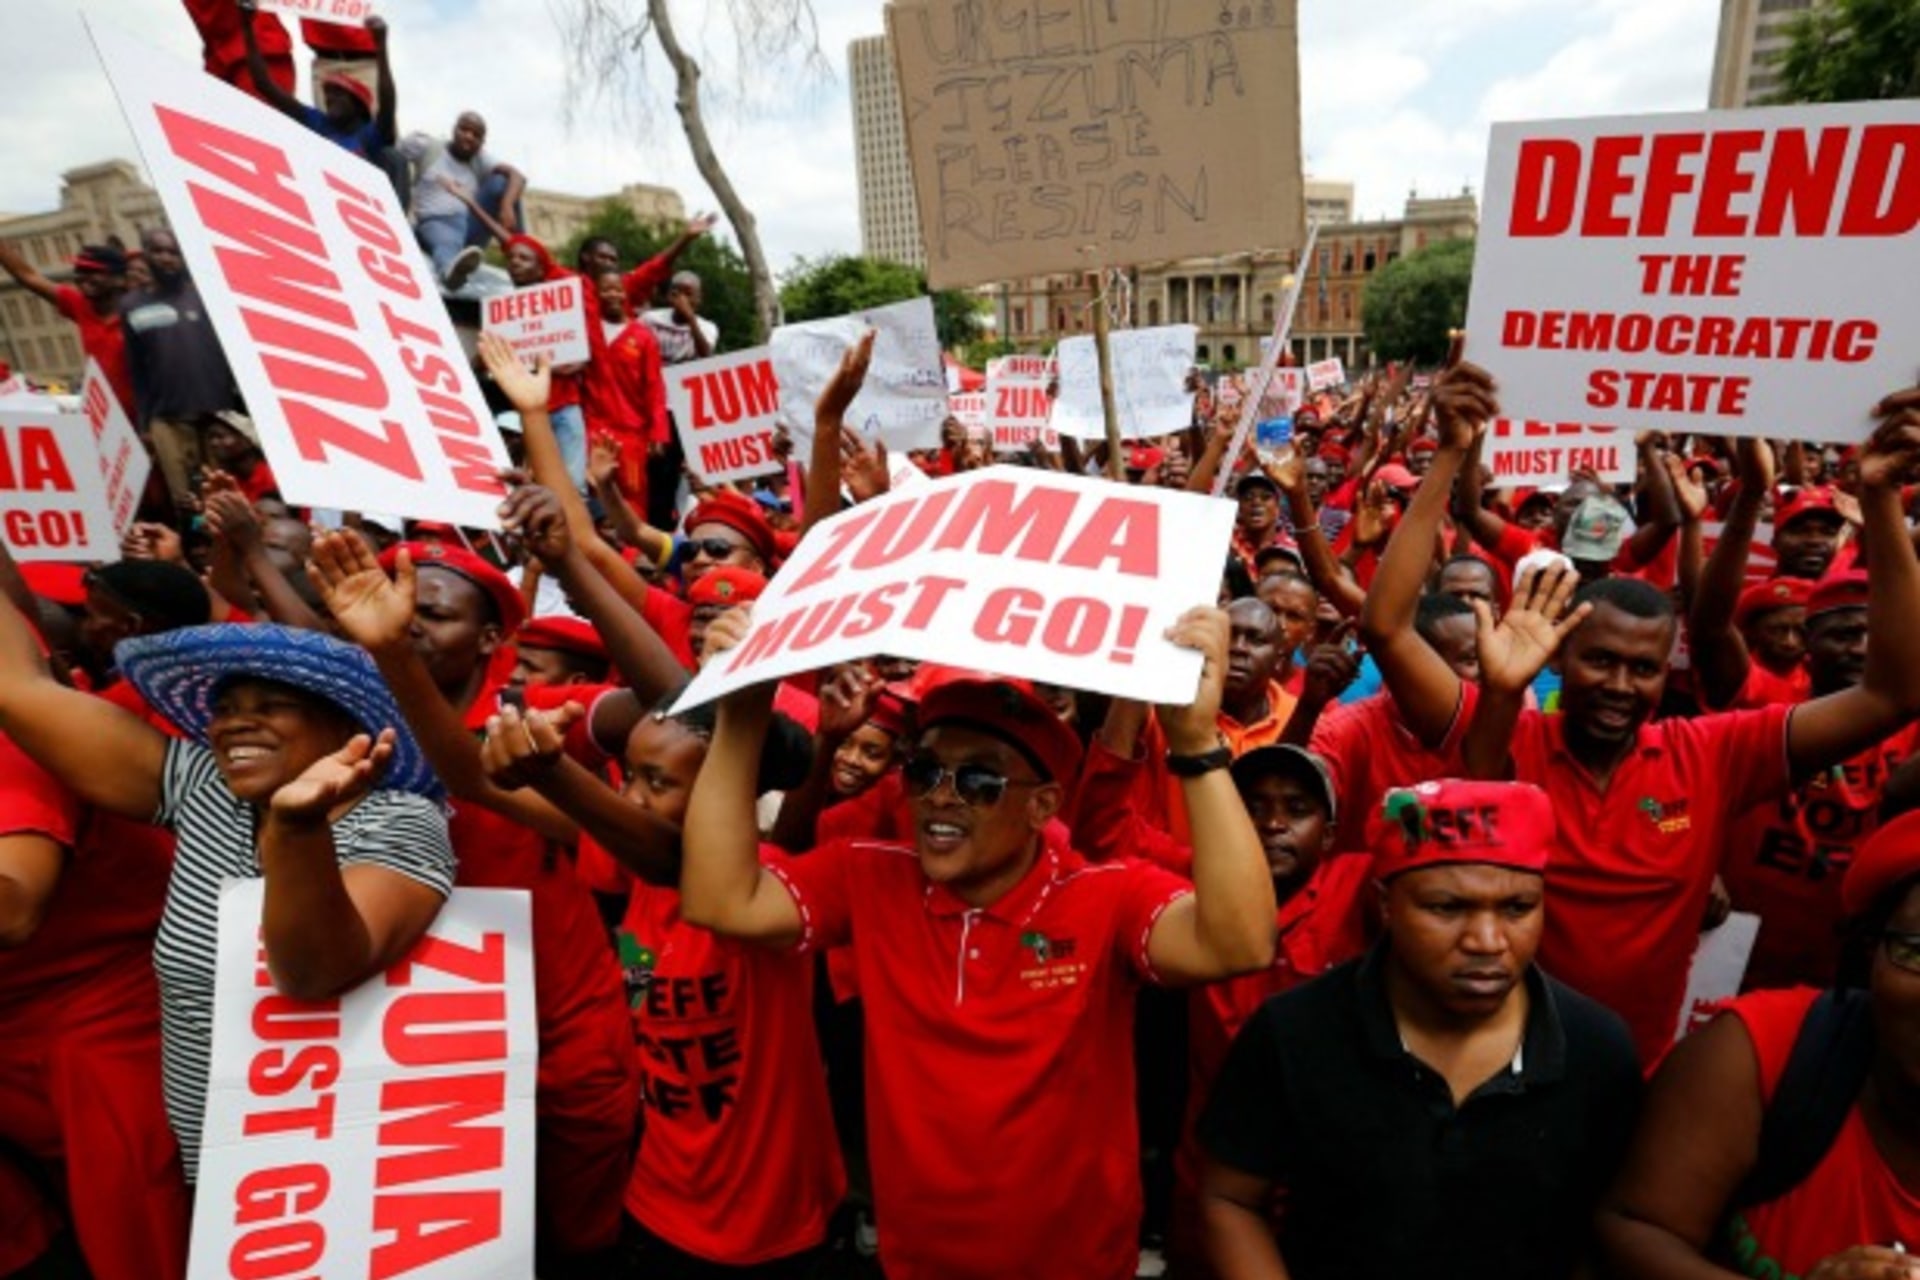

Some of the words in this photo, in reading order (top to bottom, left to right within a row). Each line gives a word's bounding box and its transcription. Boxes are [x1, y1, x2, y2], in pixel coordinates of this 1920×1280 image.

[935, 109, 1159, 185] PLEASE
[1508, 124, 1920, 237] DEFEND
[322, 171, 421, 299] GO!
[940, 165, 1207, 259] RESIGN
[153, 103, 424, 482] ZUMA
[489, 285, 573, 325] DEFEND
[1638, 254, 1746, 296] THE
[1502, 310, 1879, 362] DEMOCRATIC
[379, 302, 508, 496] MUST
[1586, 369, 1751, 415] STATE
[699, 430, 773, 474] MUST
[1493, 450, 1561, 475] MUST
[1568, 446, 1620, 473] FALL
[4, 509, 88, 547] GO!
[784, 479, 1161, 595] ZUMA
[722, 574, 966, 675] MUST
[972, 587, 1149, 666] GO!
[647, 972, 729, 1018] EFF
[370, 932, 508, 1280] ZUMA
[228, 1163, 331, 1280] GO
